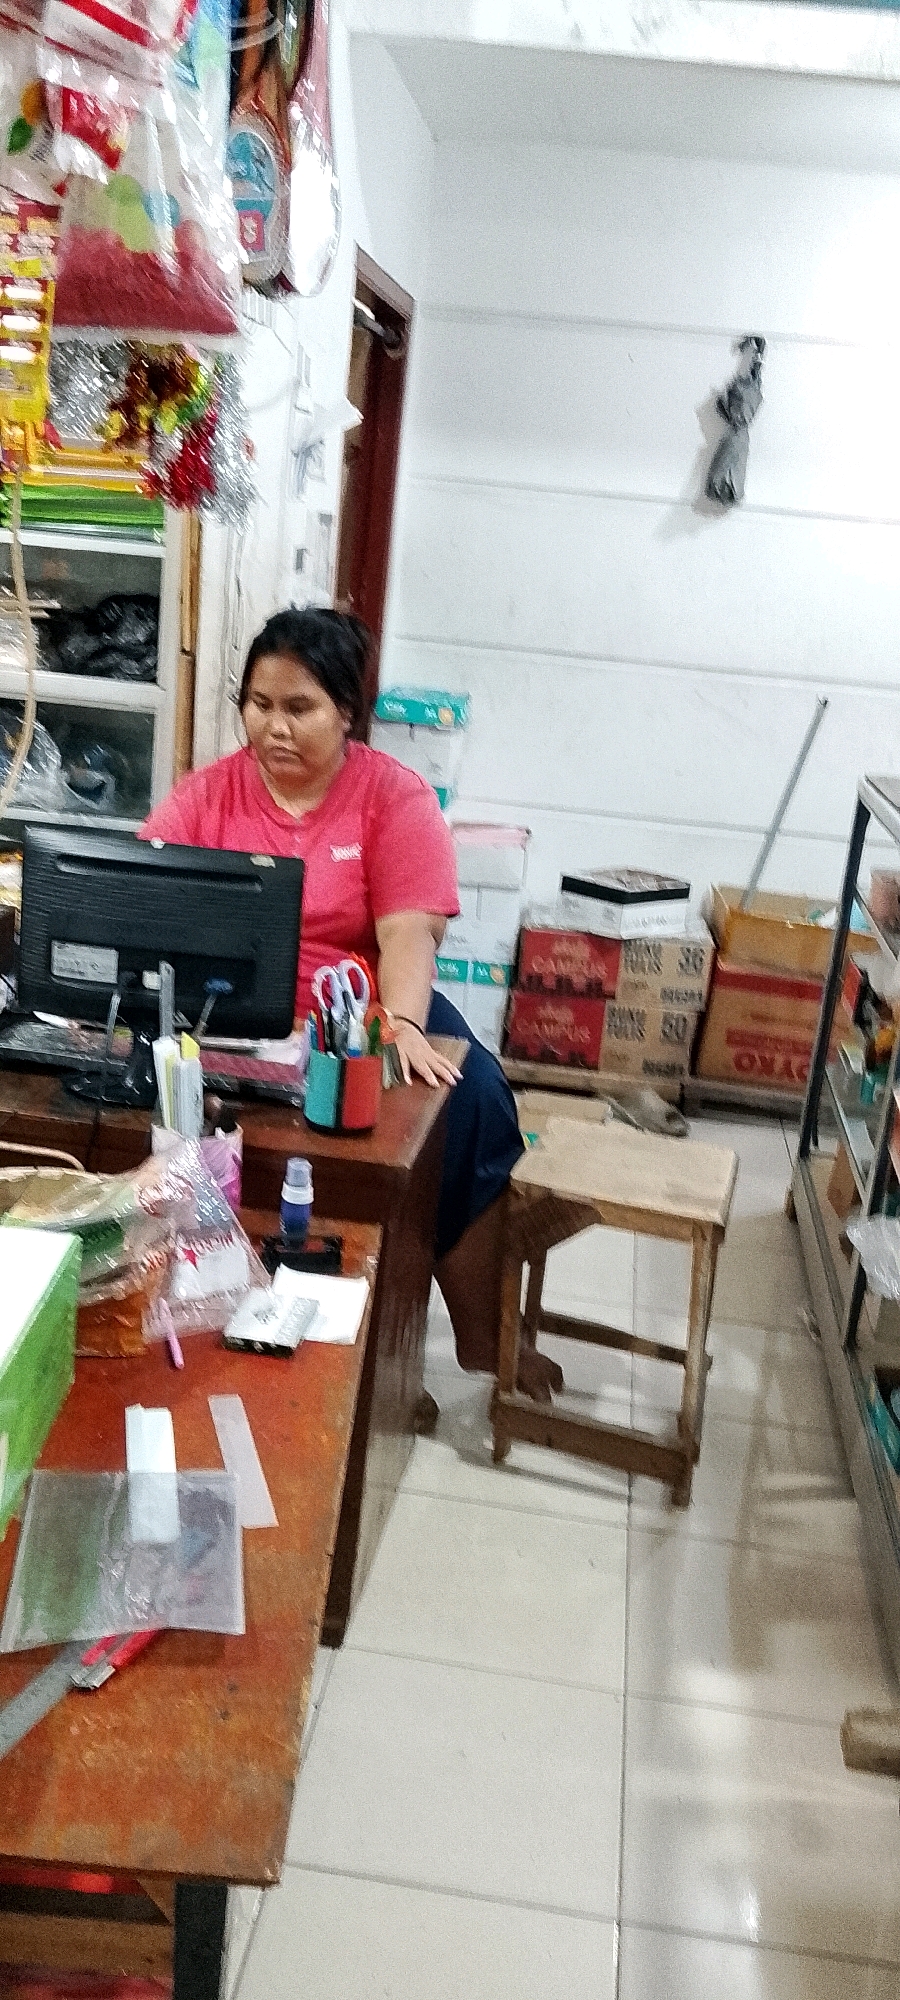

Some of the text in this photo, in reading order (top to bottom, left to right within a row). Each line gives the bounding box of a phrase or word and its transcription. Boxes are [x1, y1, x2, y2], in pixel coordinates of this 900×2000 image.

[532, 954, 608, 979] CAMPUS
[678, 946, 705, 977] 36
[516, 1018, 591, 1044] CAMPUS
